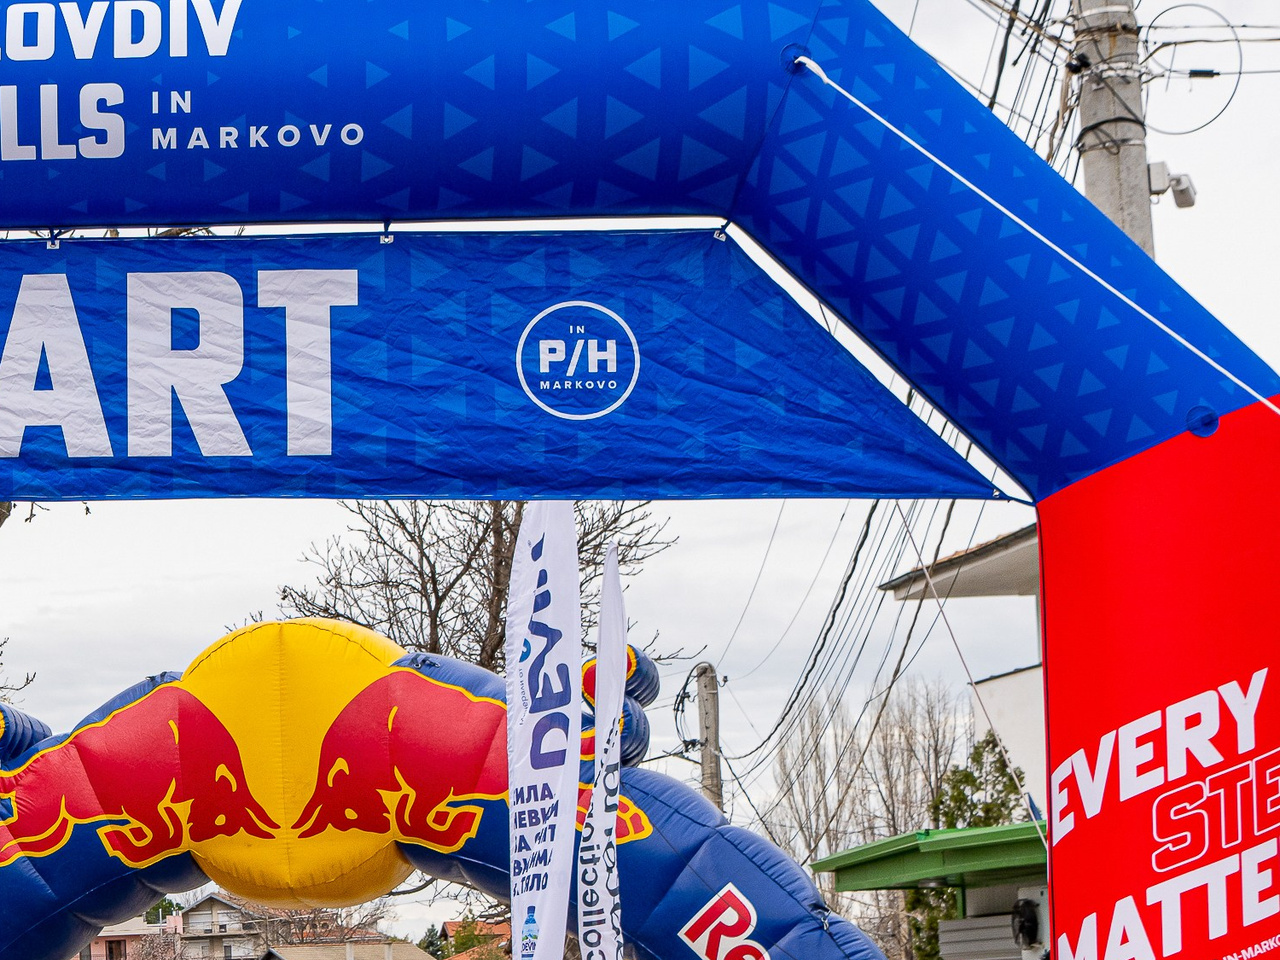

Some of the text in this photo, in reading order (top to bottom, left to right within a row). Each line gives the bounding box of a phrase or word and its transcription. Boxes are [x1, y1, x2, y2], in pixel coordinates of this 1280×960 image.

[152, 90, 192, 114] IN
[152, 123, 366, 150] MARKOVO
[569, 325, 585, 334] IN
[538, 339, 618, 377] P/H
[540, 380, 618, 390] MARKOVO
[1051, 667, 1268, 848] EVERY
[1152, 747, 1280, 873] STE
